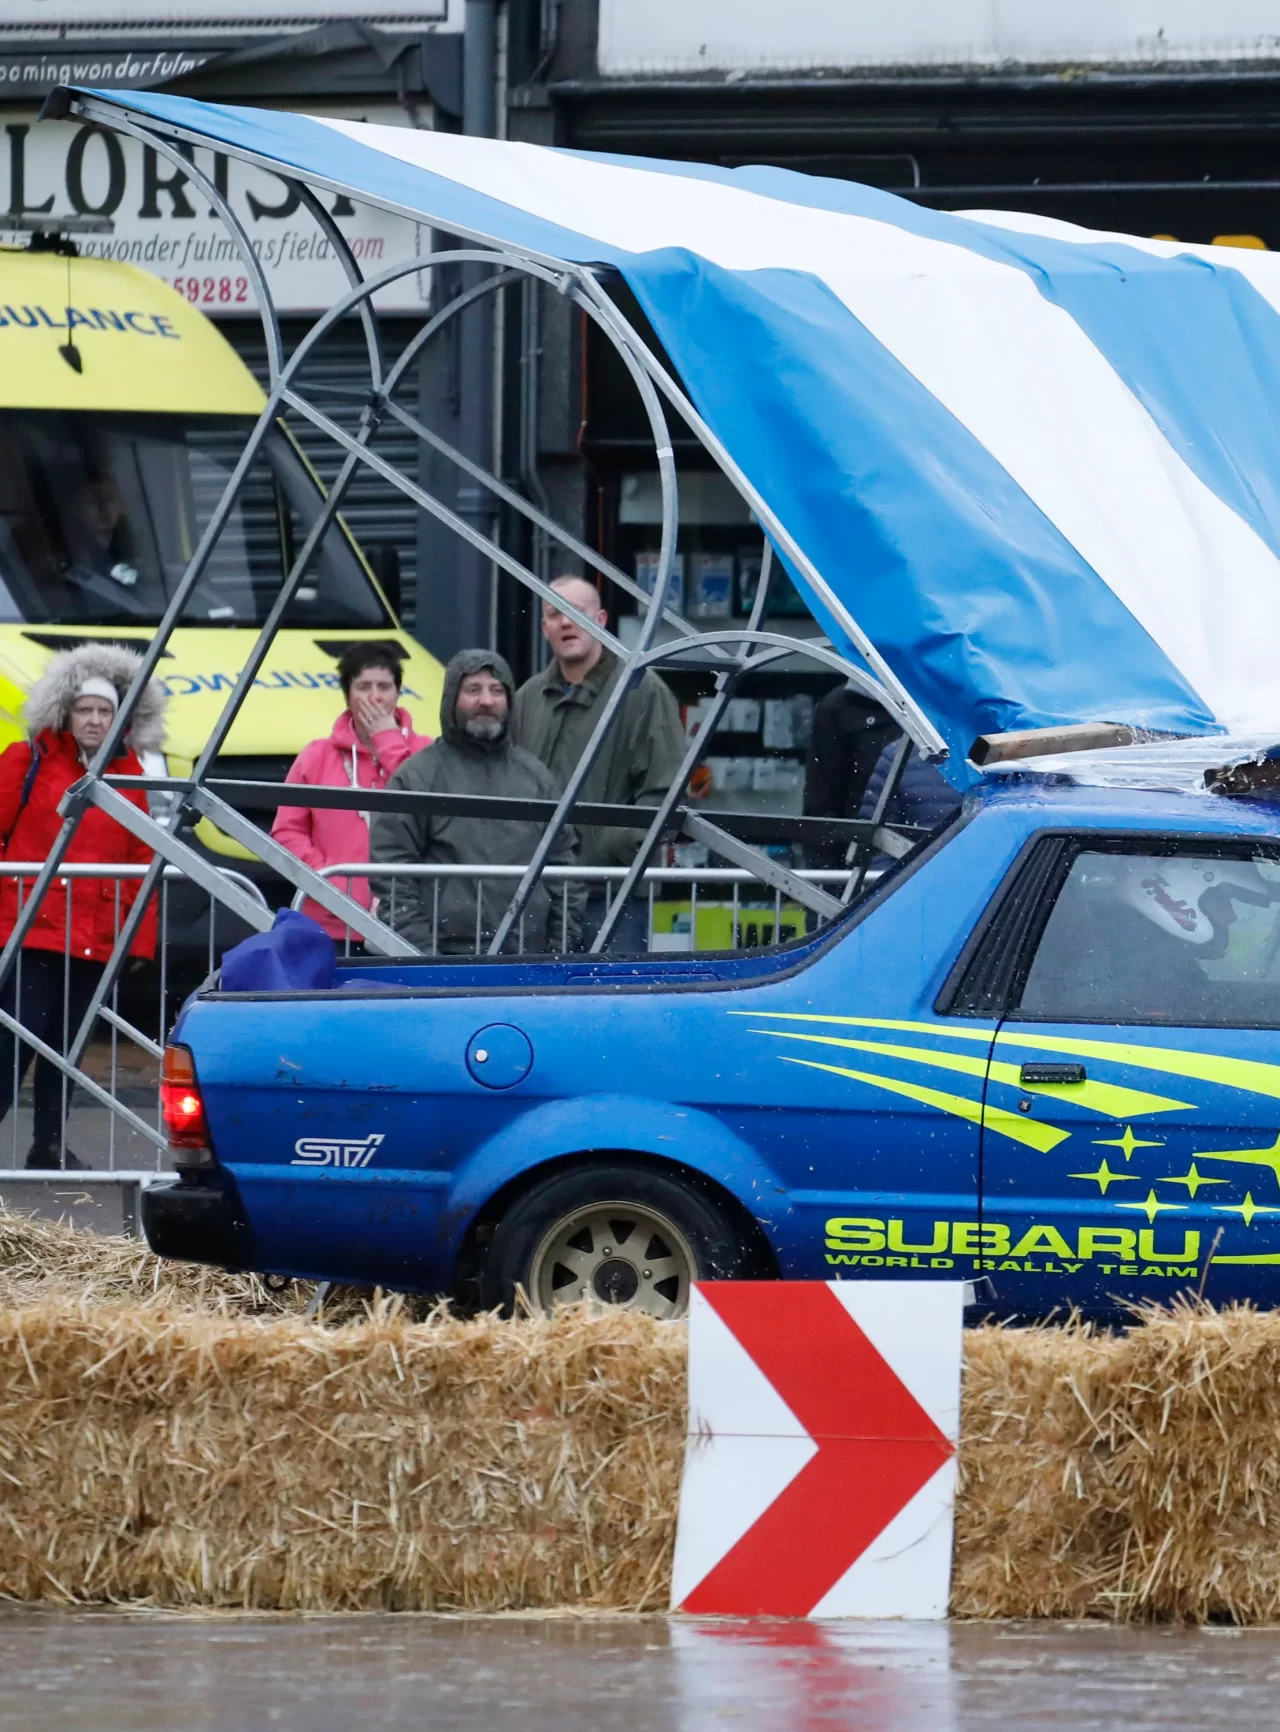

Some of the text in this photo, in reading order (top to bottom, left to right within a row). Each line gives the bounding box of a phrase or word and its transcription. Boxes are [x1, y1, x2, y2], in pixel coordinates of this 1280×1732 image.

[0, 53, 206, 86] oomingwonderfulm
[6, 116, 368, 222] LORIS
[160, 275, 248, 303] 59282
[824, 1217, 1200, 1263] SUBARU
[825, 1254, 1198, 1278] WORLD RALLY TEAM
